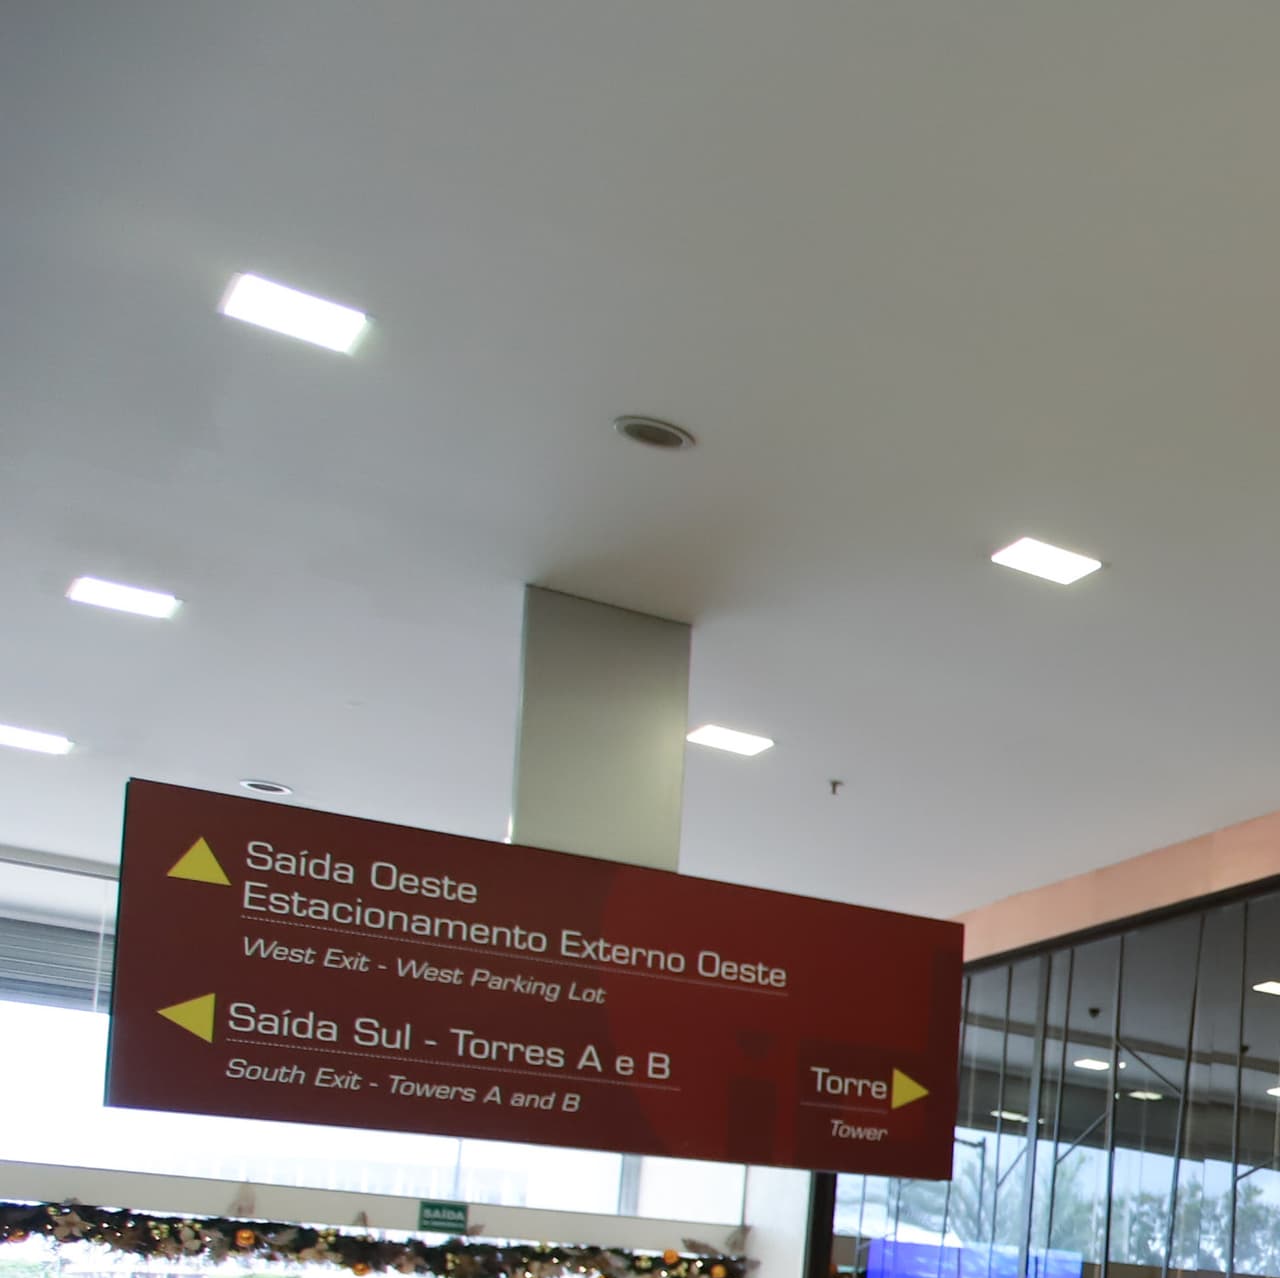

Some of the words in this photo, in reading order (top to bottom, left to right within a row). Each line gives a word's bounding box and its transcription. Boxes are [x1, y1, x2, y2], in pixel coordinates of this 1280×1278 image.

[246, 840, 354, 885] Saída
[370, 861, 478, 904] Oeste
[243, 880, 548, 954] Estacionamento
[560, 929, 685, 973] Externo
[697, 950, 787, 988] Oeste
[243, 936, 315, 965] West
[323, 948, 371, 972] Exit
[397, 957, 464, 985] West
[470, 968, 561, 1002] Parking
[568, 983, 606, 1004] Lot
[228, 1002, 338, 1042] Saída
[353, 1017, 411, 1050] Sul
[449, 1028, 565, 1068] Torres
[577, 1044, 602, 1073] A
[615, 1056, 634, 1076] e
[647, 1052, 670, 1079] B
[225, 1058, 306, 1085] South
[314, 1067, 362, 1091] Exit
[389, 1074, 477, 1102] Towers
[483, 1086, 502, 1105] A
[510, 1092, 556, 1110] and
[561, 1093, 581, 1112] B
[811, 1067, 888, 1100] Torre
[830, 1120, 888, 1142] Tower
